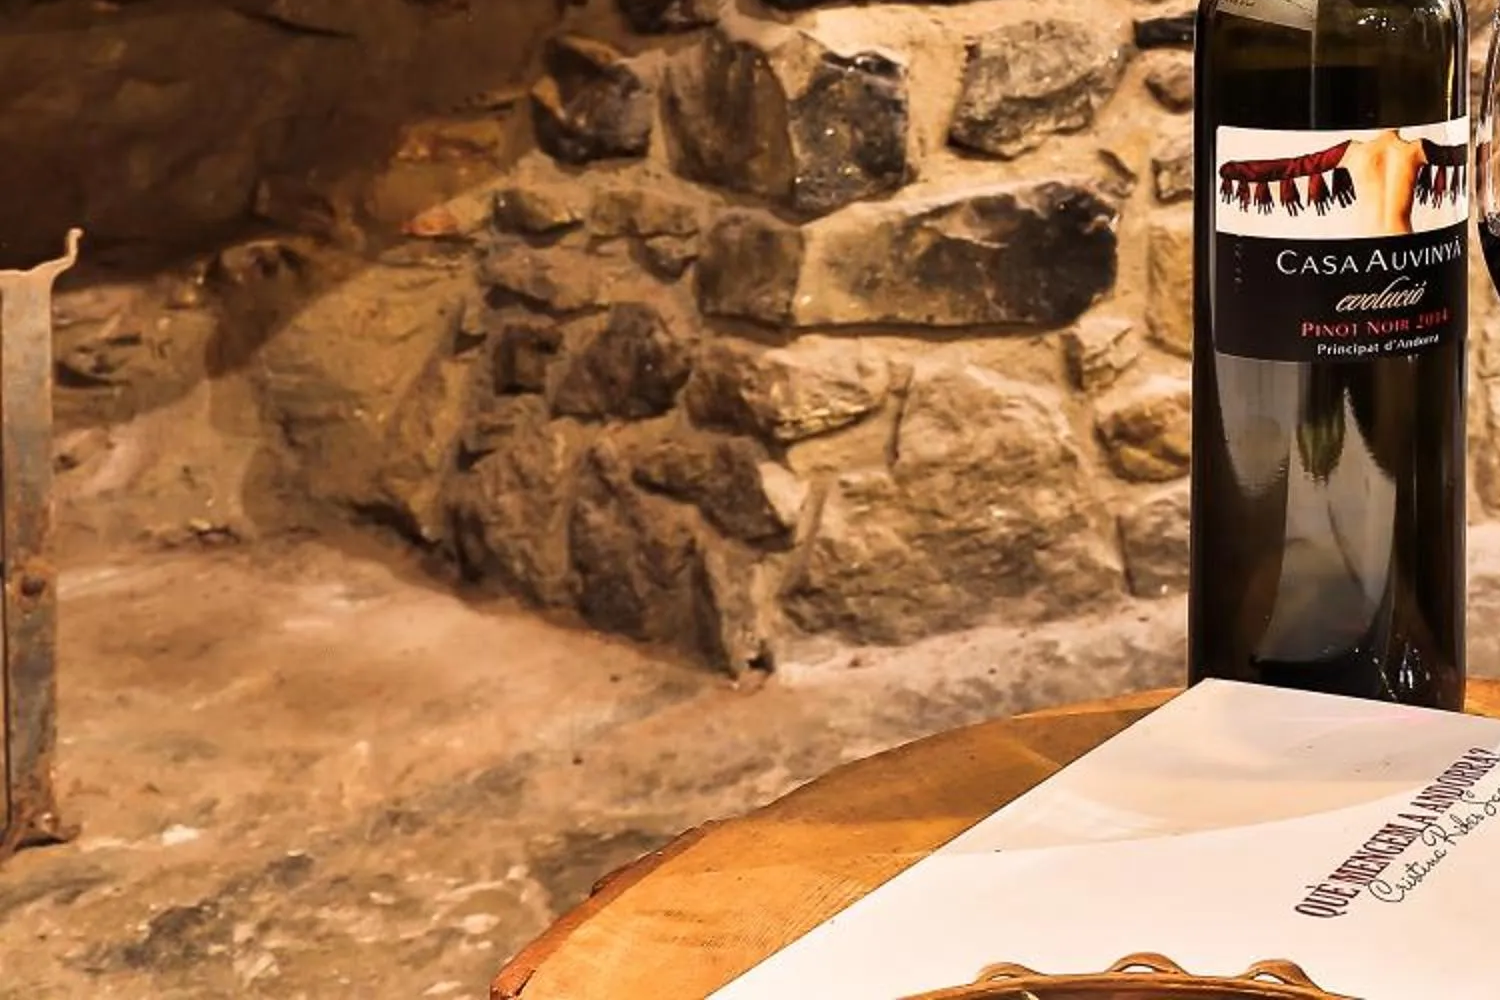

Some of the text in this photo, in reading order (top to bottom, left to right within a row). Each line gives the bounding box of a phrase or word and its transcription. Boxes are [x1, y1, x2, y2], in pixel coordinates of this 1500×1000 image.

[1276, 249, 1359, 275] CASA
[1335, 275, 1427, 313] evolució
[1301, 320, 1358, 338] PINOT
[1367, 318, 1410, 336] NOIR
[1317, 343, 1380, 357] Principat
[1328, 823, 1422, 886] MENGEM
[1397, 812, 1438, 825] A
[1367, 849, 1447, 902] Cristina
